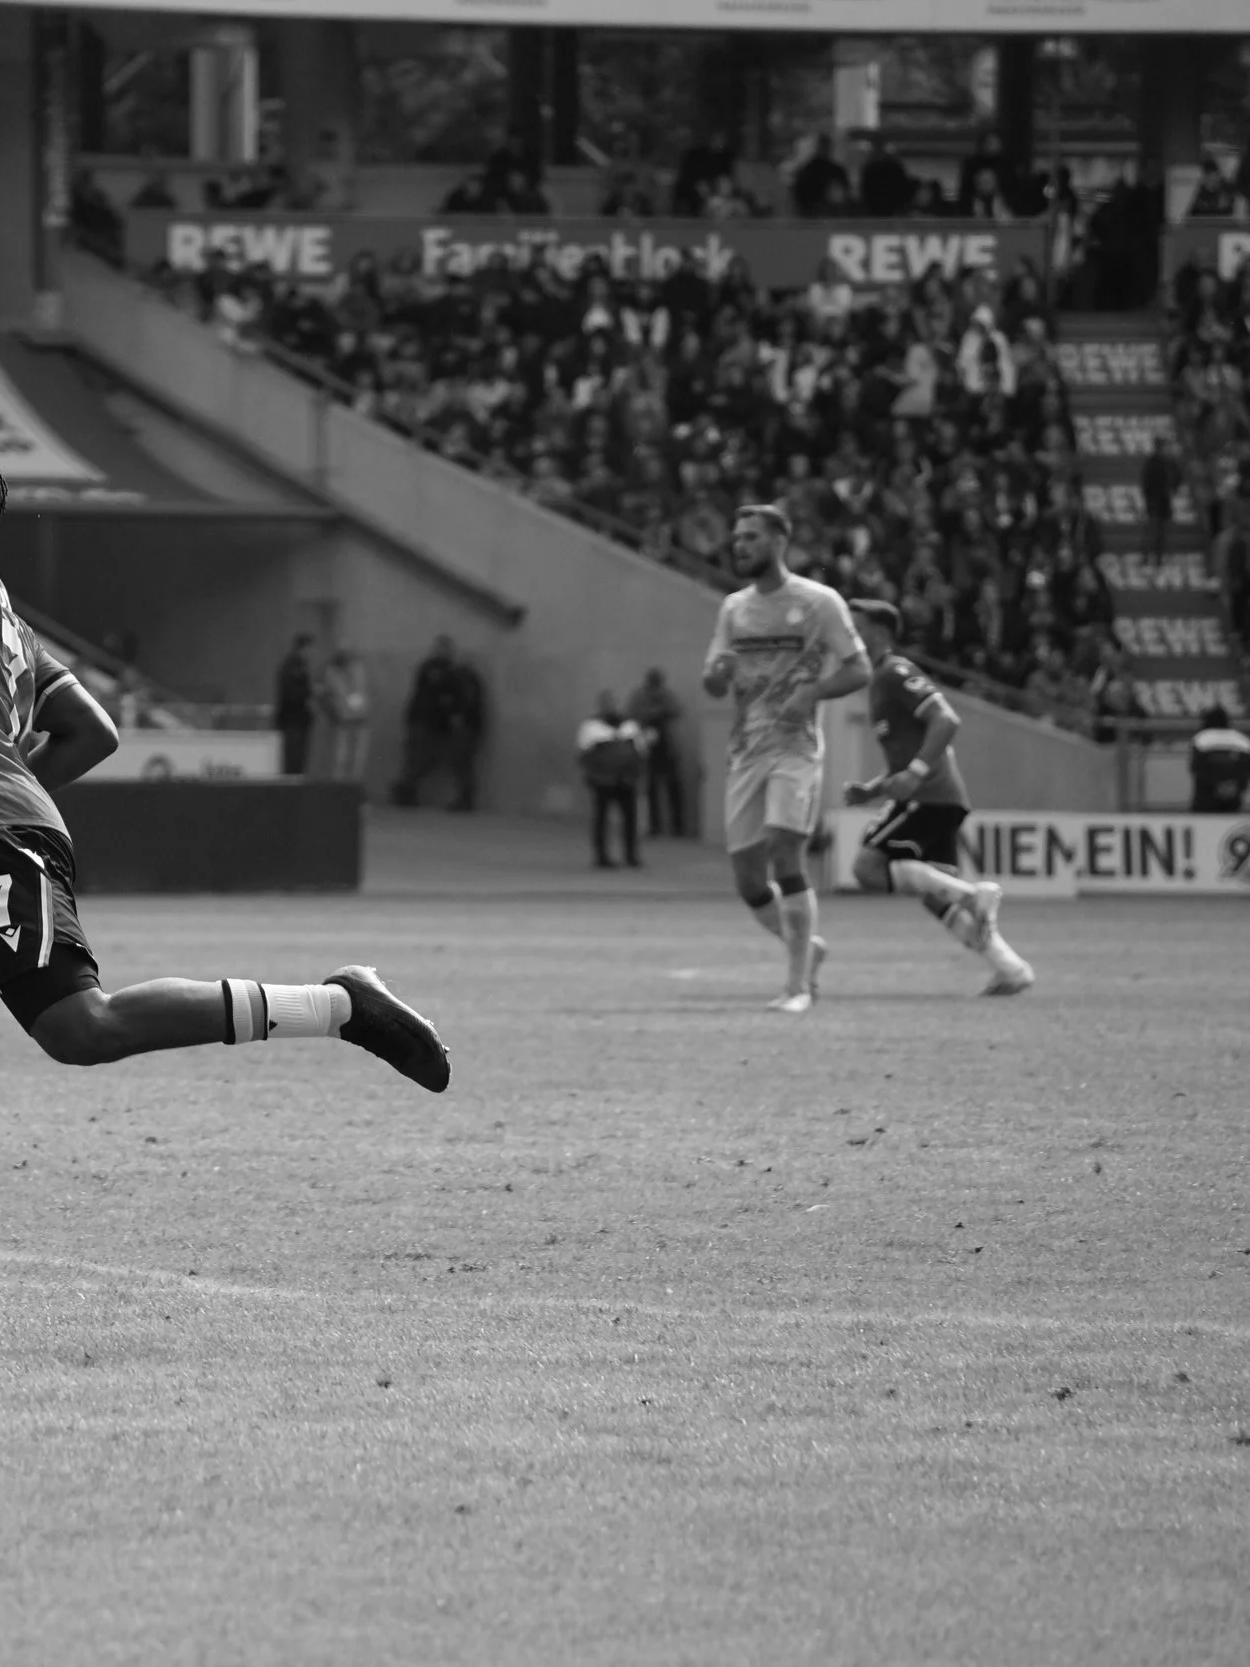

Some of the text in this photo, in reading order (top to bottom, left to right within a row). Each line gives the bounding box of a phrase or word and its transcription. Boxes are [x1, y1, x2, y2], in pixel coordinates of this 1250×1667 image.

[167, 223, 333, 275] REWE
[828, 232, 999, 283] REWE
[1055, 342, 1165, 385] REWE
[1082, 484, 1197, 525] REE
[1113, 616, 1228, 657] REWE
[1131, 680, 1245, 717] REWE
